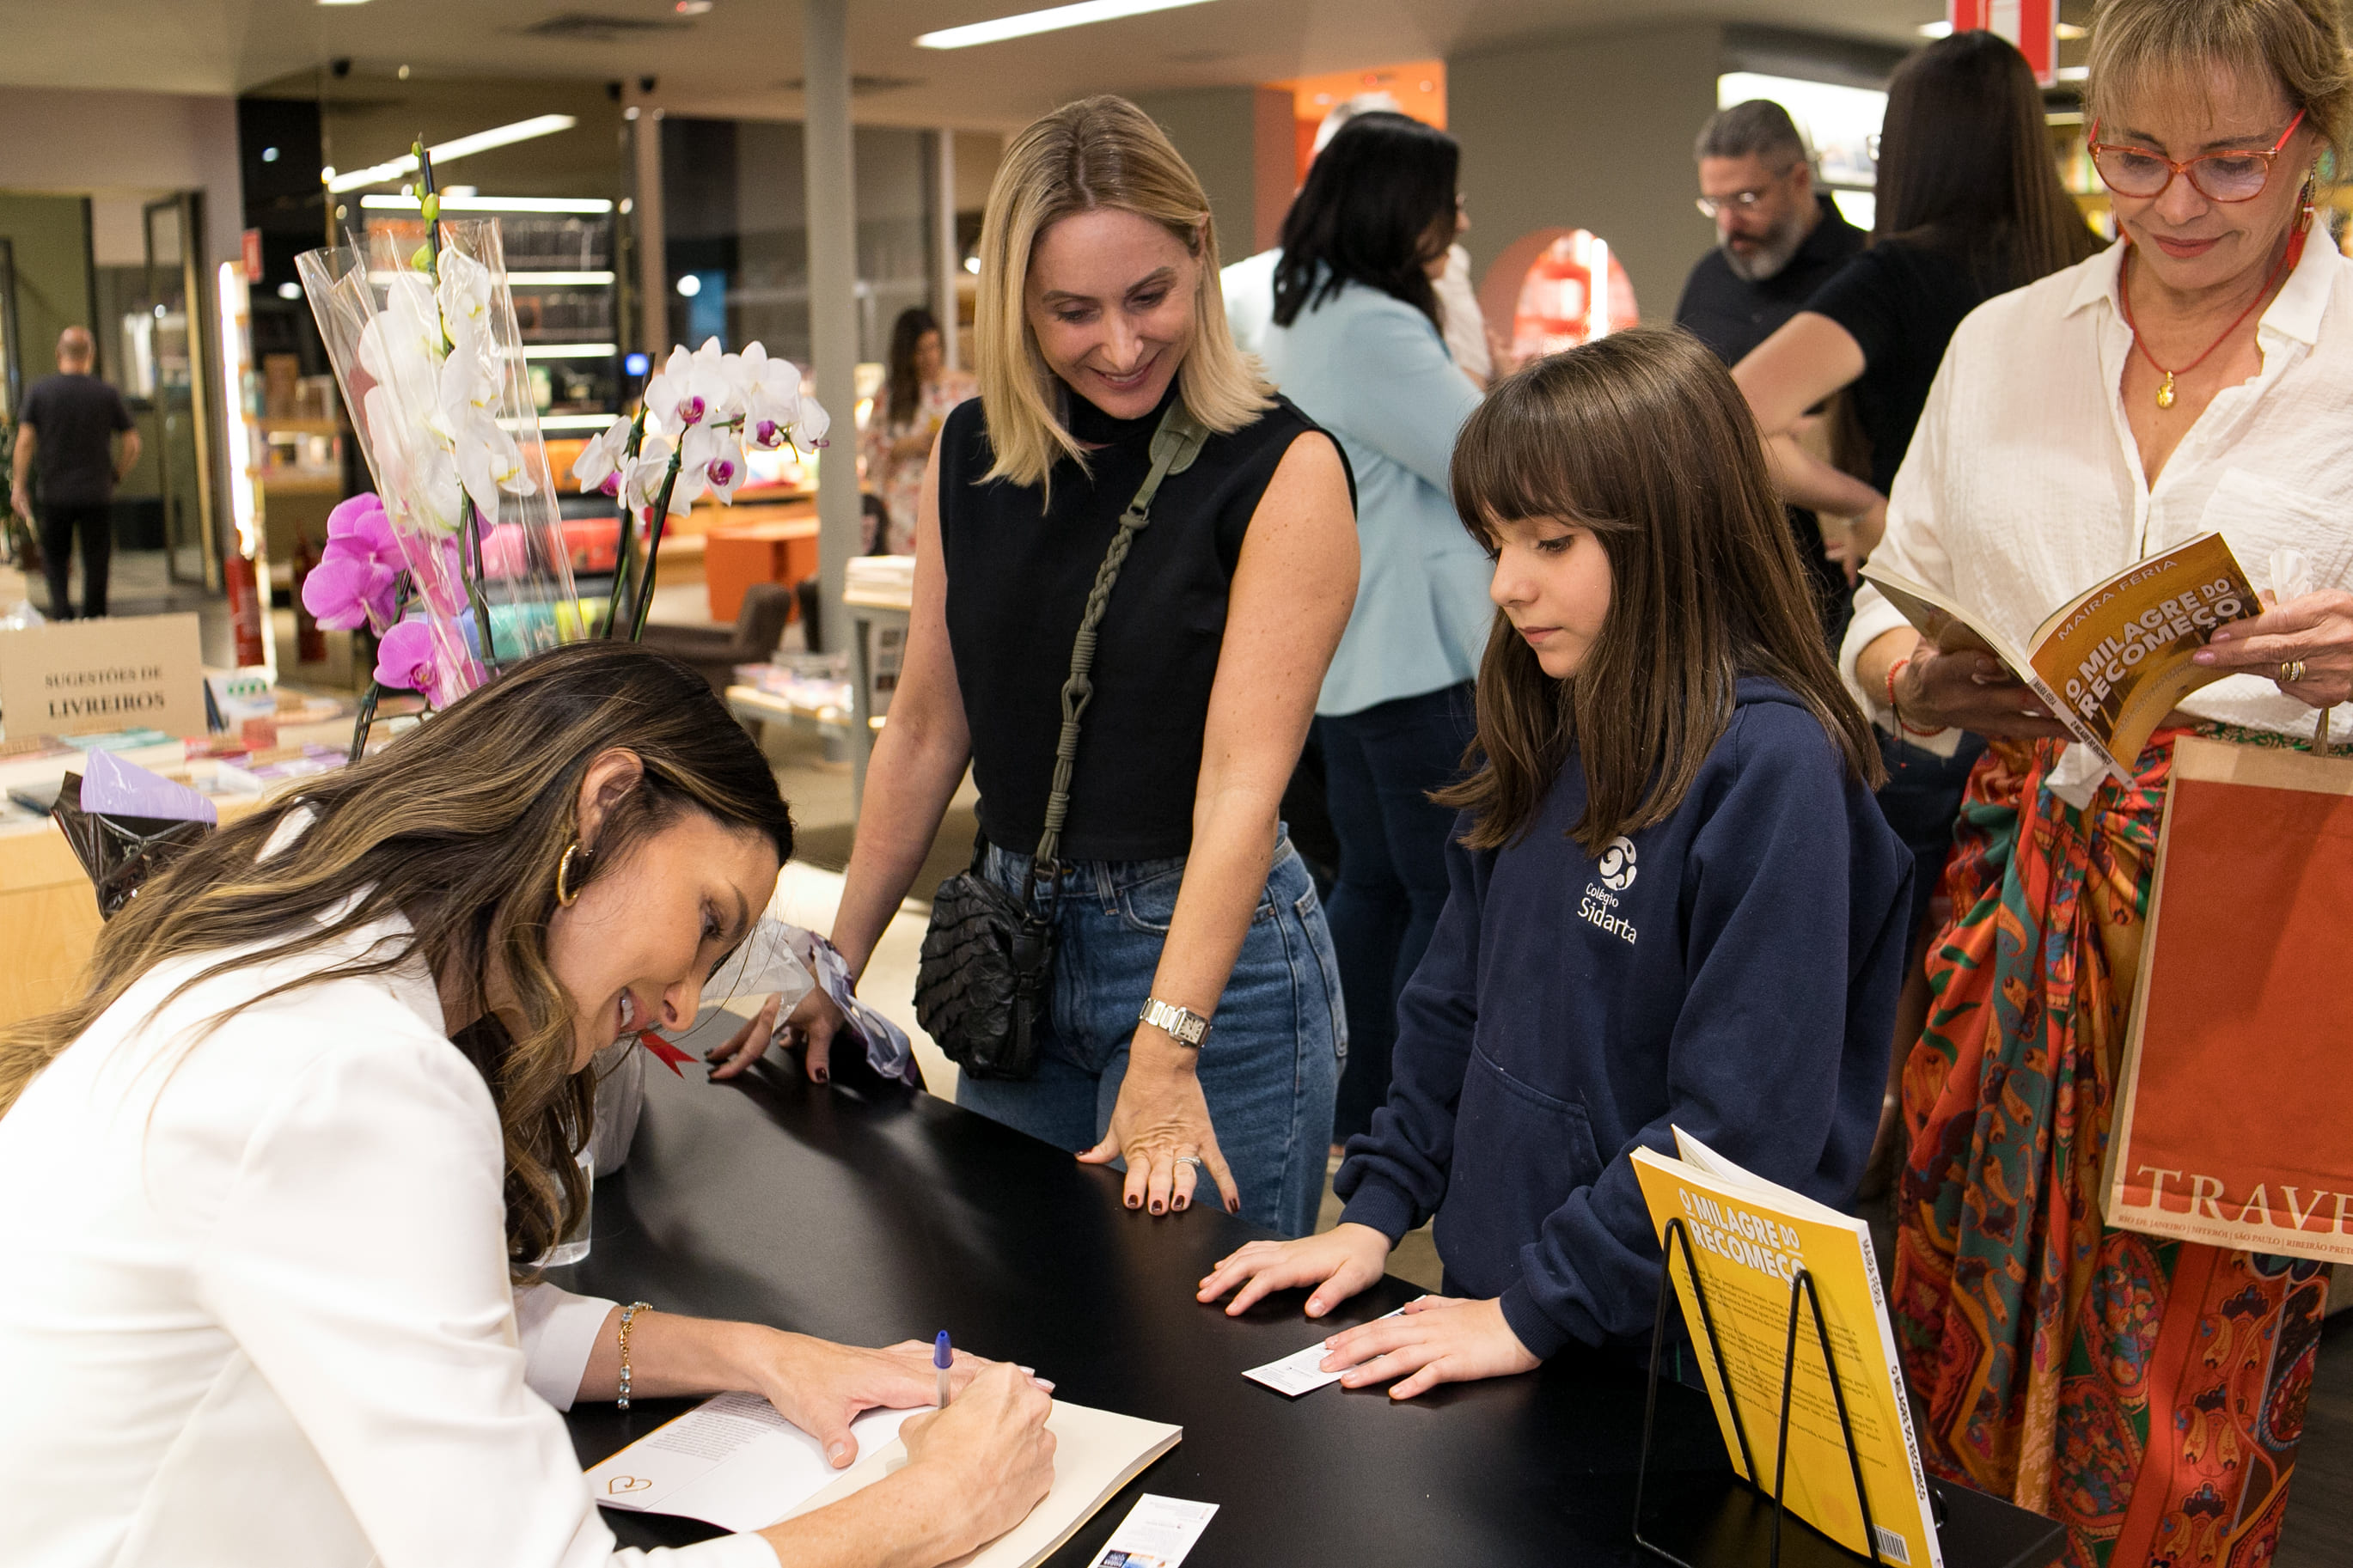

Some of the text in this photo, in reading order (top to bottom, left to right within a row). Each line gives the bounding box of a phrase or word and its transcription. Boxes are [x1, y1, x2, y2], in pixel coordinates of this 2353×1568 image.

[2057, 559, 2178, 641] MAIRA FÉRIA
[2065, 577, 2230, 699] O MILAGRE DO
[2076, 598, 2242, 720] RECOMEÇO
[48, 690, 165, 718] LIVREIROS
[1577, 897, 1637, 945] Sidarta
[1586, 882, 1619, 907] Colégio
[1678, 1187, 1800, 1250] O MILAGRE DO
[2252, 1235, 2280, 1245] PAULO
[2286, 1240, 2327, 1251] RIBEIRÃO
[2329, 1244, 2353, 1254] PRET
